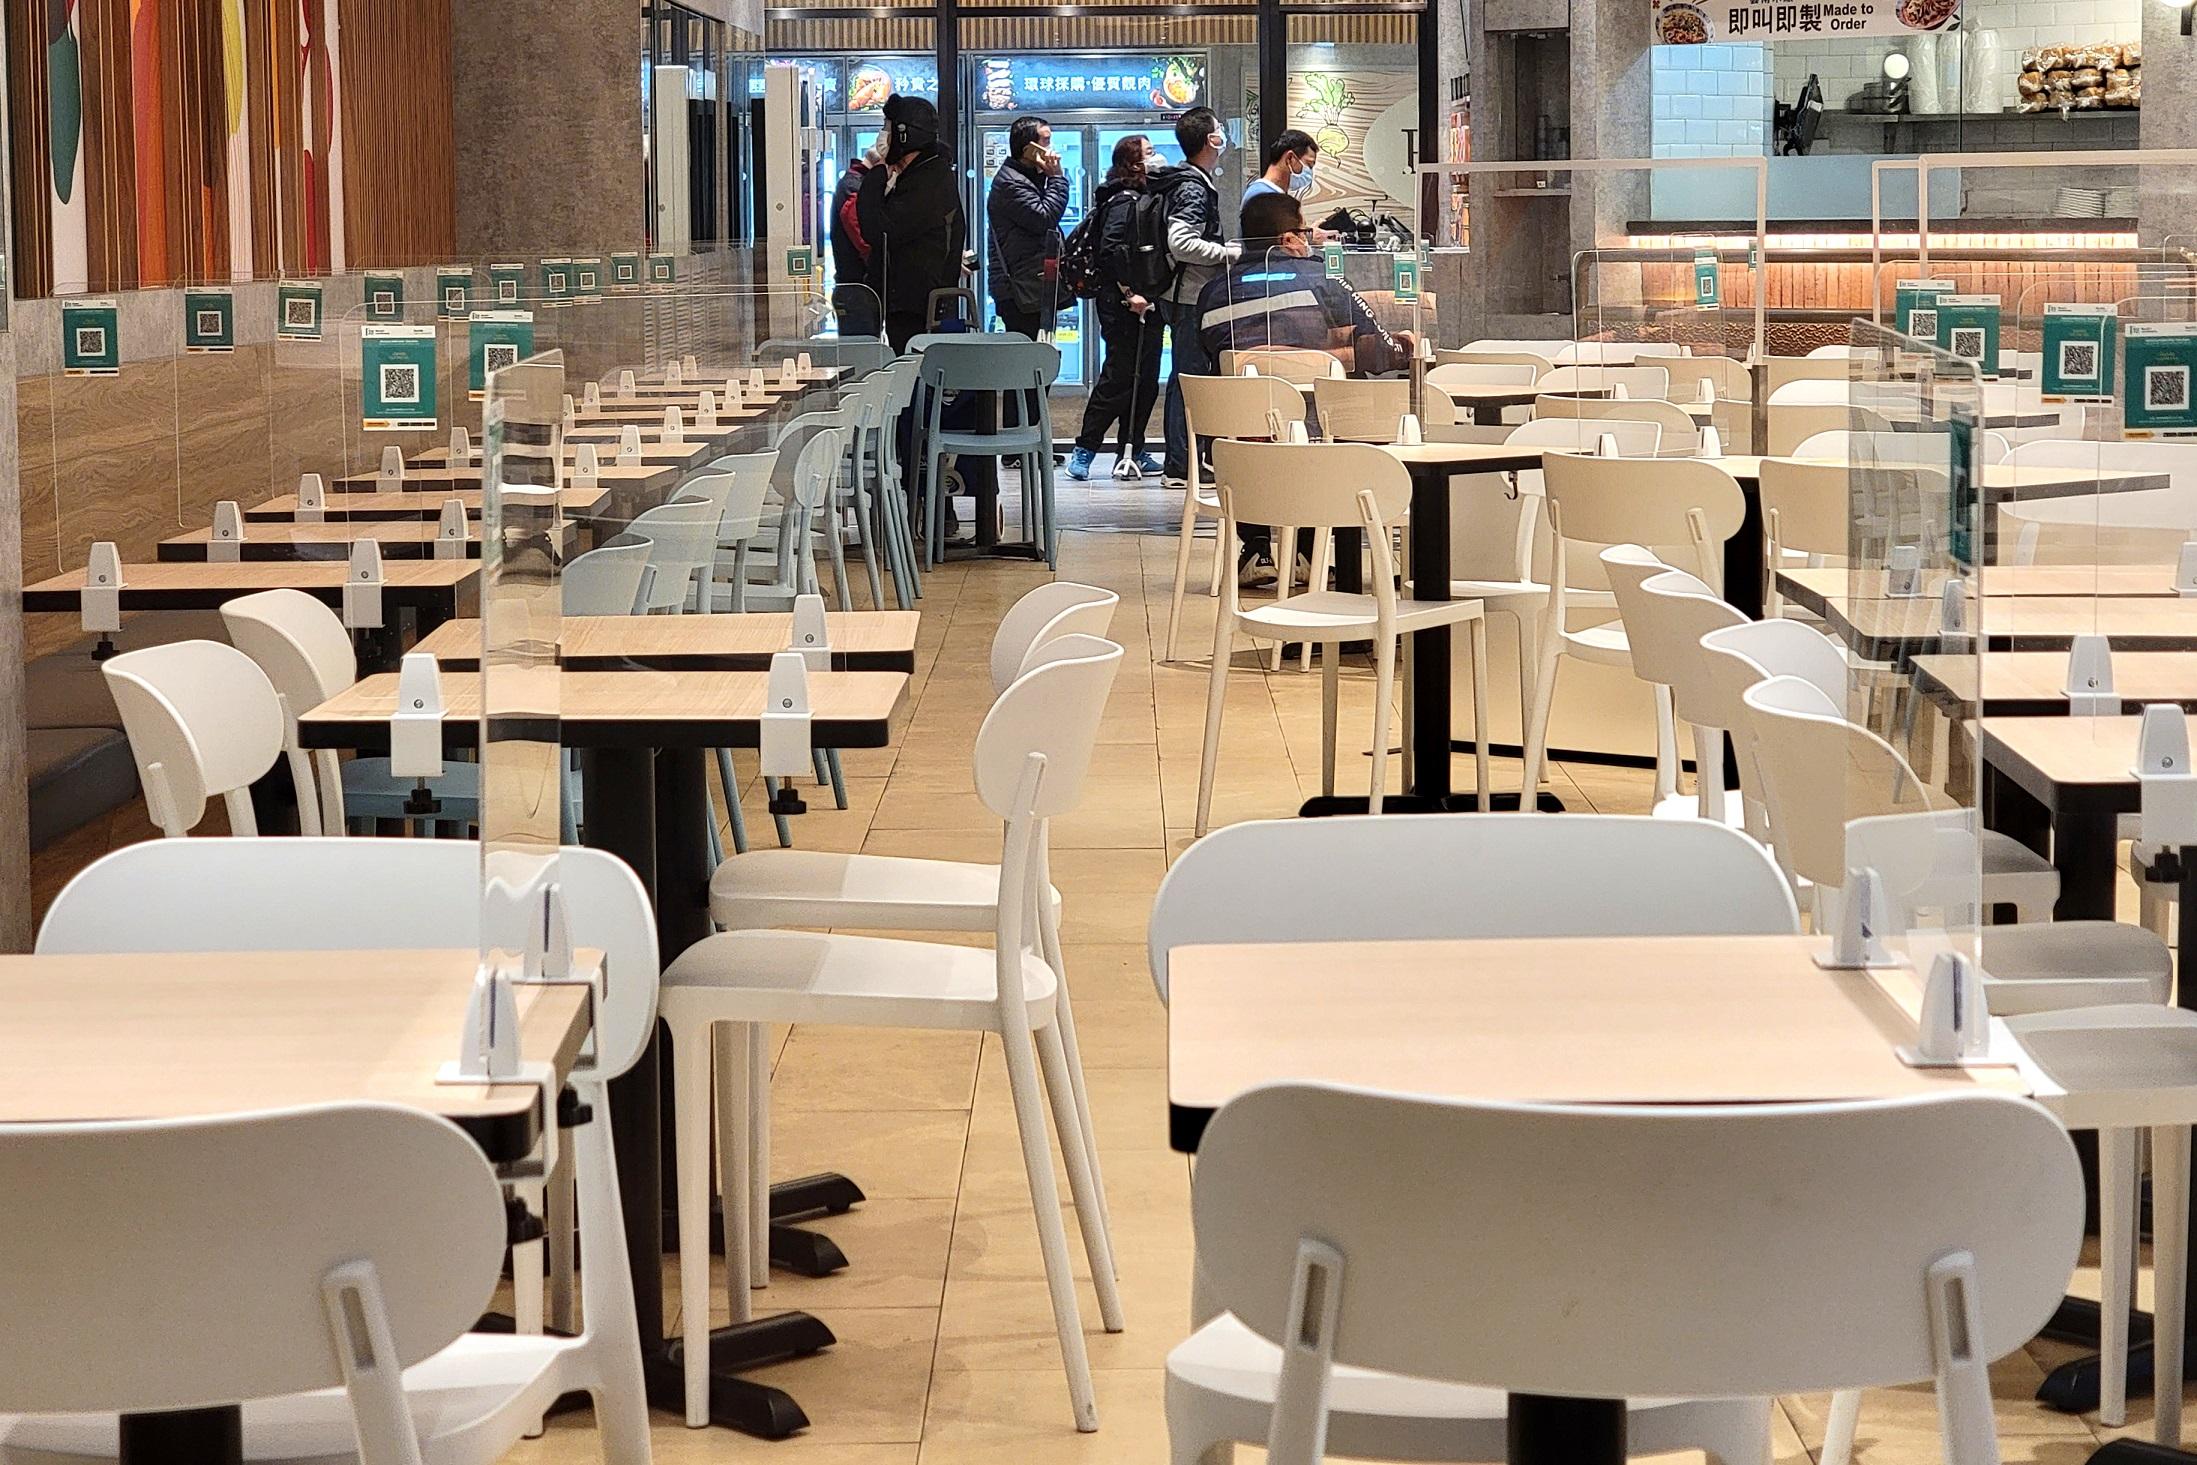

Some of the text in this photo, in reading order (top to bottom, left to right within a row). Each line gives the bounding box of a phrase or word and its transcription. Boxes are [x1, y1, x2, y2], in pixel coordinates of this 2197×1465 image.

[1823, 3, 1874, 16] Made to
[1729, 3, 1822, 34] 即叫即製
[1831, 17, 1866, 30] Order
